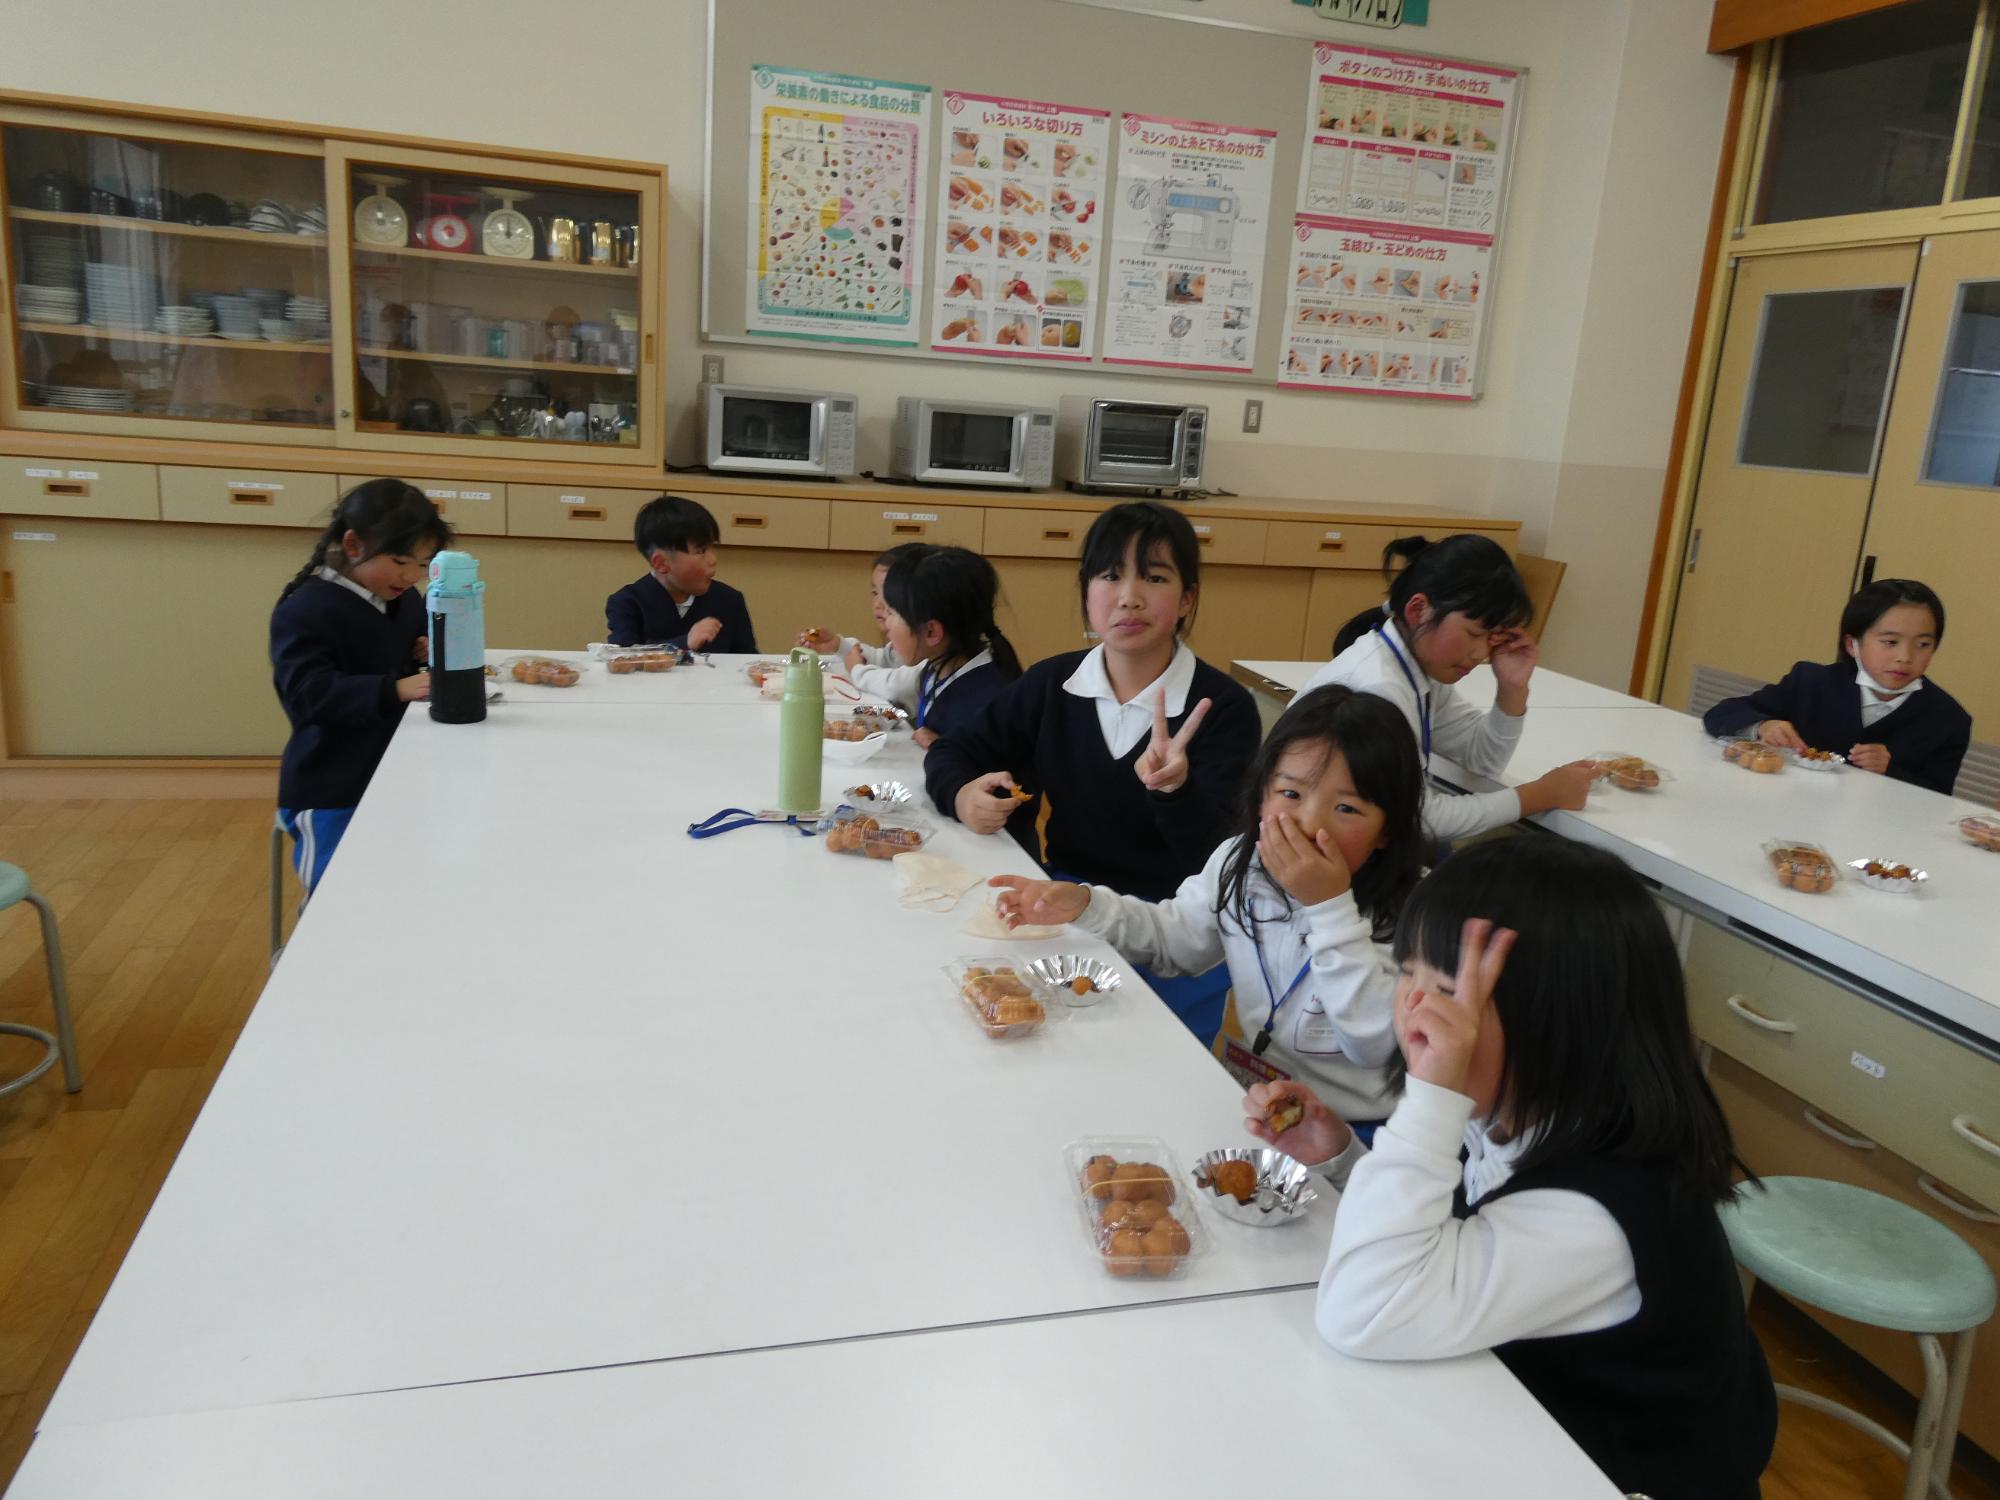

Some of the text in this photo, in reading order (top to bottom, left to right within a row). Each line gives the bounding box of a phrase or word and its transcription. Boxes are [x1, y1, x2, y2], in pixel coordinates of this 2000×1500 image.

[1338, 60, 1491, 94] ボタンのつけ方・手ぬいの仕方
[775, 82, 921, 113] 栄養素の働きによる食品の分類
[982, 111, 1085, 136] いろいろな切り方
[1140, 130, 1265, 158] ミシンの上糸と下糸のかけ方
[1339, 238, 1448, 262] 玉結び・玉どめの仕方
